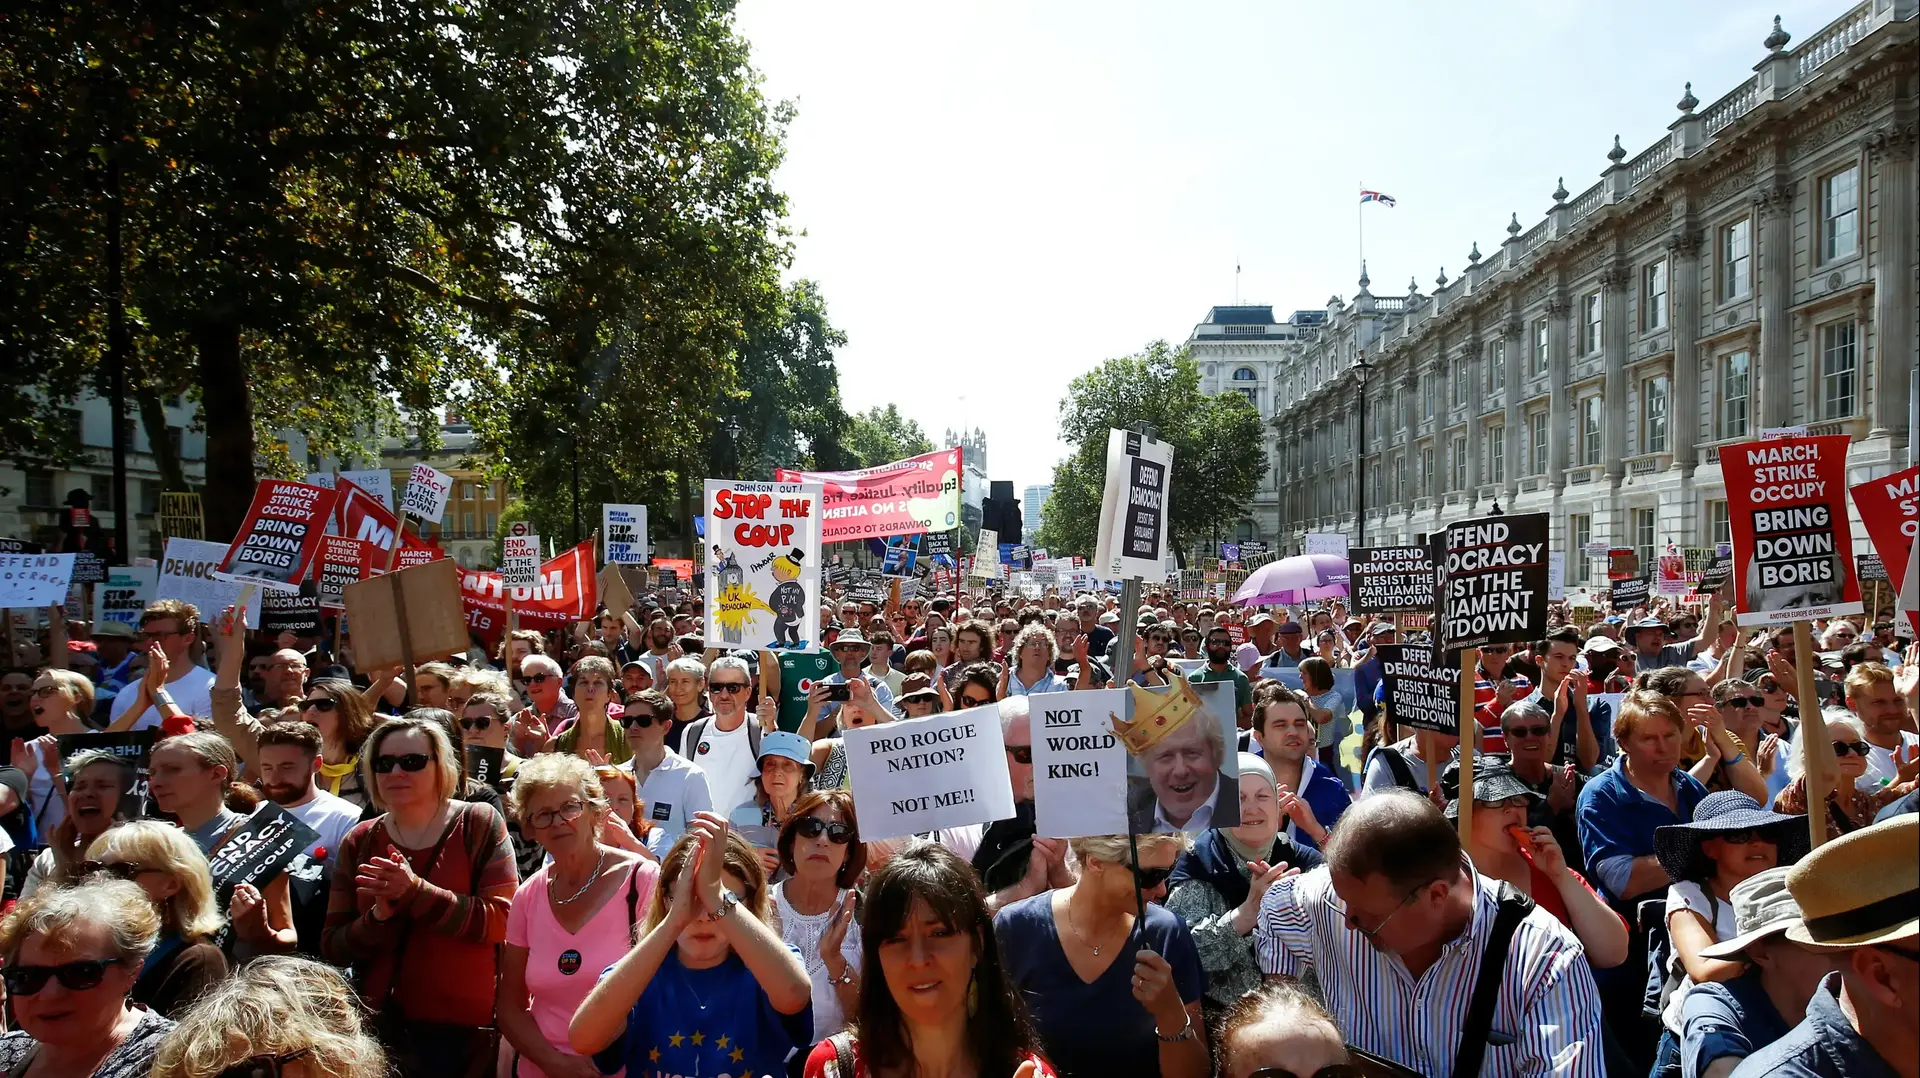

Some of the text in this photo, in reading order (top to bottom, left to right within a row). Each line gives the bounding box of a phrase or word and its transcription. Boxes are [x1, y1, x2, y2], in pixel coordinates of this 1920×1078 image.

[1747, 443, 1821, 466] MARCH,
[358, 475, 379, 486] 1933
[1139, 465, 1159, 487] DEFEND
[1754, 463, 1820, 484] STRIKE,
[410, 474, 446, 493] CRACY
[733, 483, 803, 493] JOHNSON OUT!
[272, 484, 320, 501] MARCH,
[418, 485, 436, 499] THE
[1130, 486, 1162, 510] DEMOCRACY
[1750, 481, 1826, 503] OCCUPY
[161, 495, 201, 516] REMAIN
[269, 496, 313, 511] STRIKE,
[713, 489, 811, 519] STOP THE
[262, 505, 316, 521] OCCUPY
[1137, 511, 1147, 524] RESIST
[1754, 506, 1829, 533] BRING
[254, 518, 306, 536] BRING
[609, 525, 632, 533] STOP
[1133, 525, 1155, 539] PARLIAMENT
[608, 534, 638, 543] BORIS!
[734, 522, 794, 548] COUP
[246, 534, 301, 552] DOWN
[504, 538, 526, 548] END
[608, 544, 631, 553] STOP
[1132, 541, 1152, 554] SHUTDOWN
[1756, 533, 1833, 559] DOWN
[240, 549, 291, 567] BORIS
[324, 553, 362, 564] OCCUPY
[504, 547, 537, 557] CRACY
[608, 554, 641, 562] BREXIT!
[1370, 548, 1424, 561] DEFEND
[1685, 549, 1715, 560] REMAIN
[515, 558, 532, 566] THE
[1247, 552, 1277, 569] REMAIN
[1353, 560, 1433, 574] DEMOCRAC
[164, 558, 219, 581] DEMOC
[323, 563, 360, 575] BRING
[1181, 570, 1204, 580] REMAIN
[1226, 570, 1248, 581] REMAI
[1762, 560, 1832, 586] BORIS
[322, 574, 359, 584] DOWN
[504, 575, 535, 583] DOWN
[1181, 580, 1204, 589] REFORM
[1364, 573, 1434, 586] RESIST THE
[1481, 571, 1523, 593] THE
[1620, 580, 1643, 588] DEFEND
[104, 589, 136, 600] STOP
[264, 588, 300, 598] DEFEND
[780, 587, 801, 595] NOT MY
[1181, 590, 1204, 599] REVOLT
[1359, 584, 1433, 597] PARLIAMEN
[1613, 584, 1649, 595] DEMOCRACY
[103, 600, 145, 609] BORIS!
[461, 596, 505, 611] TOWER
[728, 594, 741, 602] UK
[1360, 595, 1435, 607] SHUTDOWN
[721, 602, 752, 611] DEMOCRACY
[1769, 611, 1791, 620] ANOTHER
[1791, 610, 1808, 618] EUROPE
[1813, 607, 1832, 616] POSSIBLE
[103, 611, 136, 621] STOP
[1404, 614, 1428, 627] REVOL
[1384, 662, 1461, 682] DEMOCRACY
[1397, 678, 1451, 699] RESIST THE
[1393, 691, 1456, 713] PARLIAMENT
[1045, 709, 1082, 725] NOT
[1395, 704, 1456, 727] SHUTDOWN
[870, 724, 977, 755] PRO ROGUE
[1046, 734, 1116, 751] WORLD
[887, 747, 965, 773] NATION?
[1048, 761, 1099, 779] KING!
[891, 788, 975, 816] NOT ME!!
[212, 812, 286, 876] CRACY
[248, 821, 294, 859] SHUTDOWN
[215, 838, 294, 947] #STOECOUP
